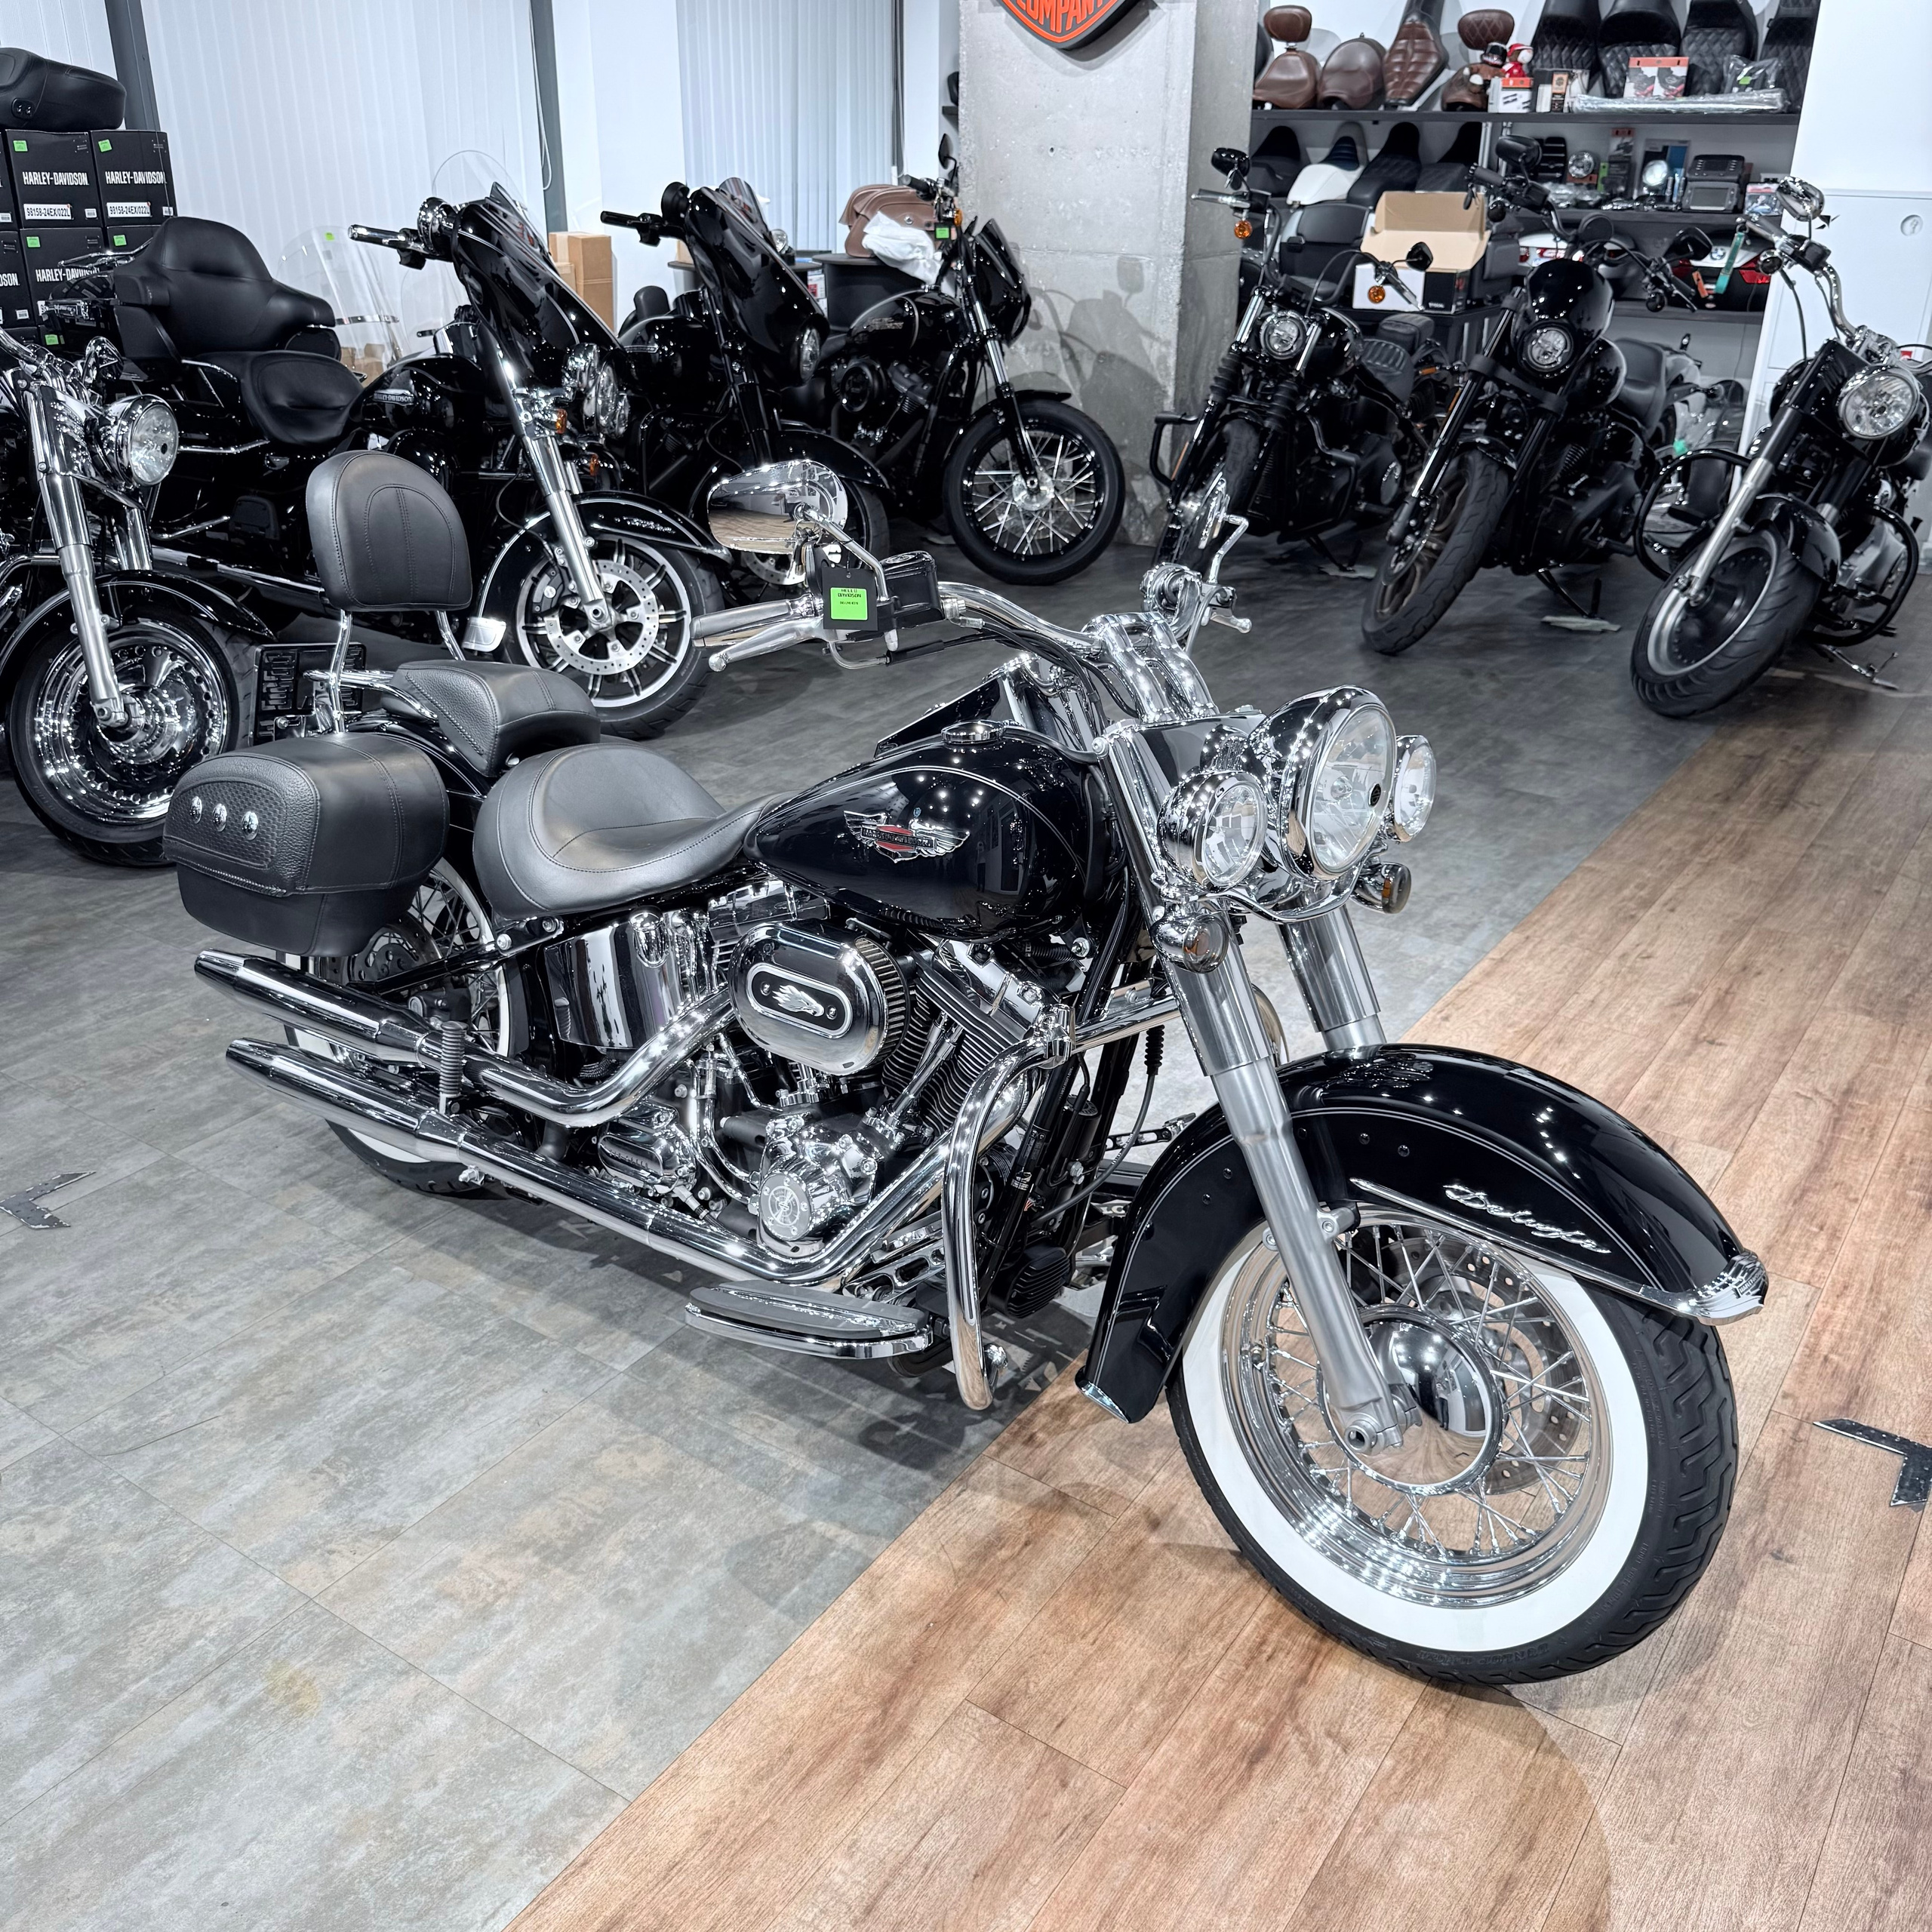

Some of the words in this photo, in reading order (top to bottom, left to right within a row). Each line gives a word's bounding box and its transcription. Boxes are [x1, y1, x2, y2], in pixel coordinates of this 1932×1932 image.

[23, 171, 88, 186] HARLEY-DAVIDSON
[105, 171, 166, 184] HARLEY-DAVIDSON
[35, 268, 100, 282] HARLEY-DAVID
